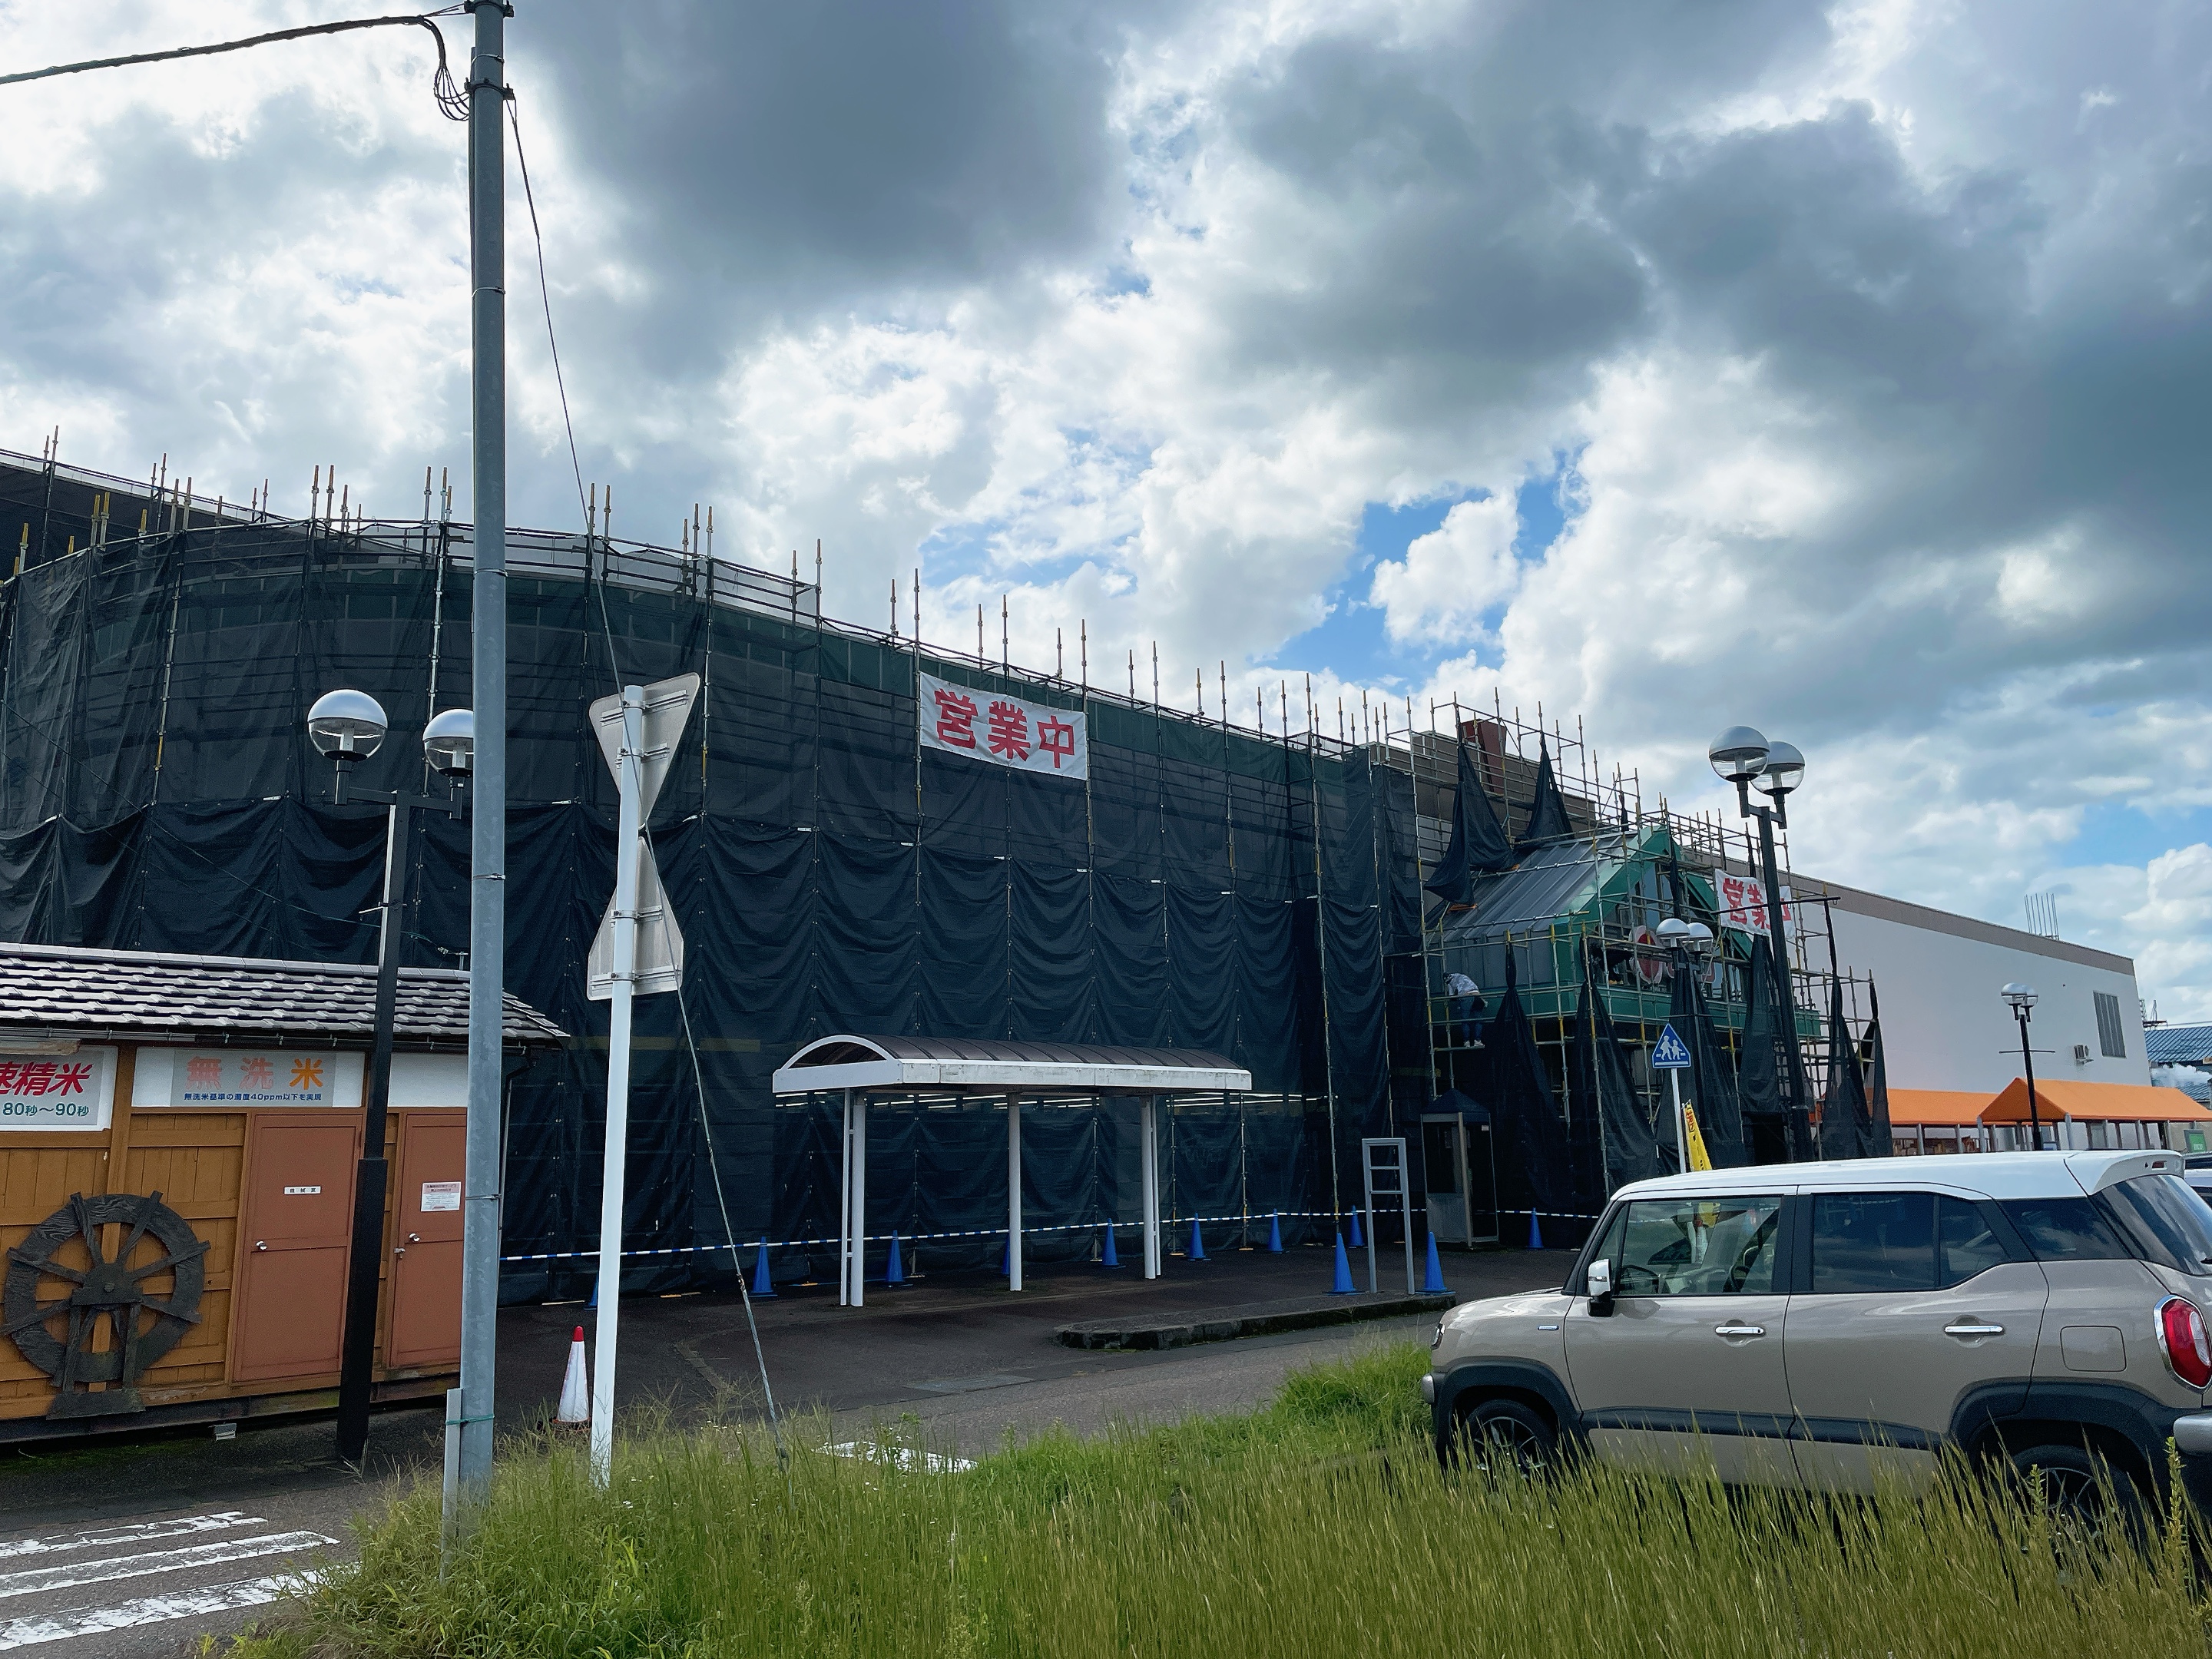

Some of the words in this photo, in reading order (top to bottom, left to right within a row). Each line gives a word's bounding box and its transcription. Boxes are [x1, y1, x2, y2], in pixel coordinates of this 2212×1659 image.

[933, 688, 1075, 769] 営業中
[185, 1055, 324, 1091] 無洗米
